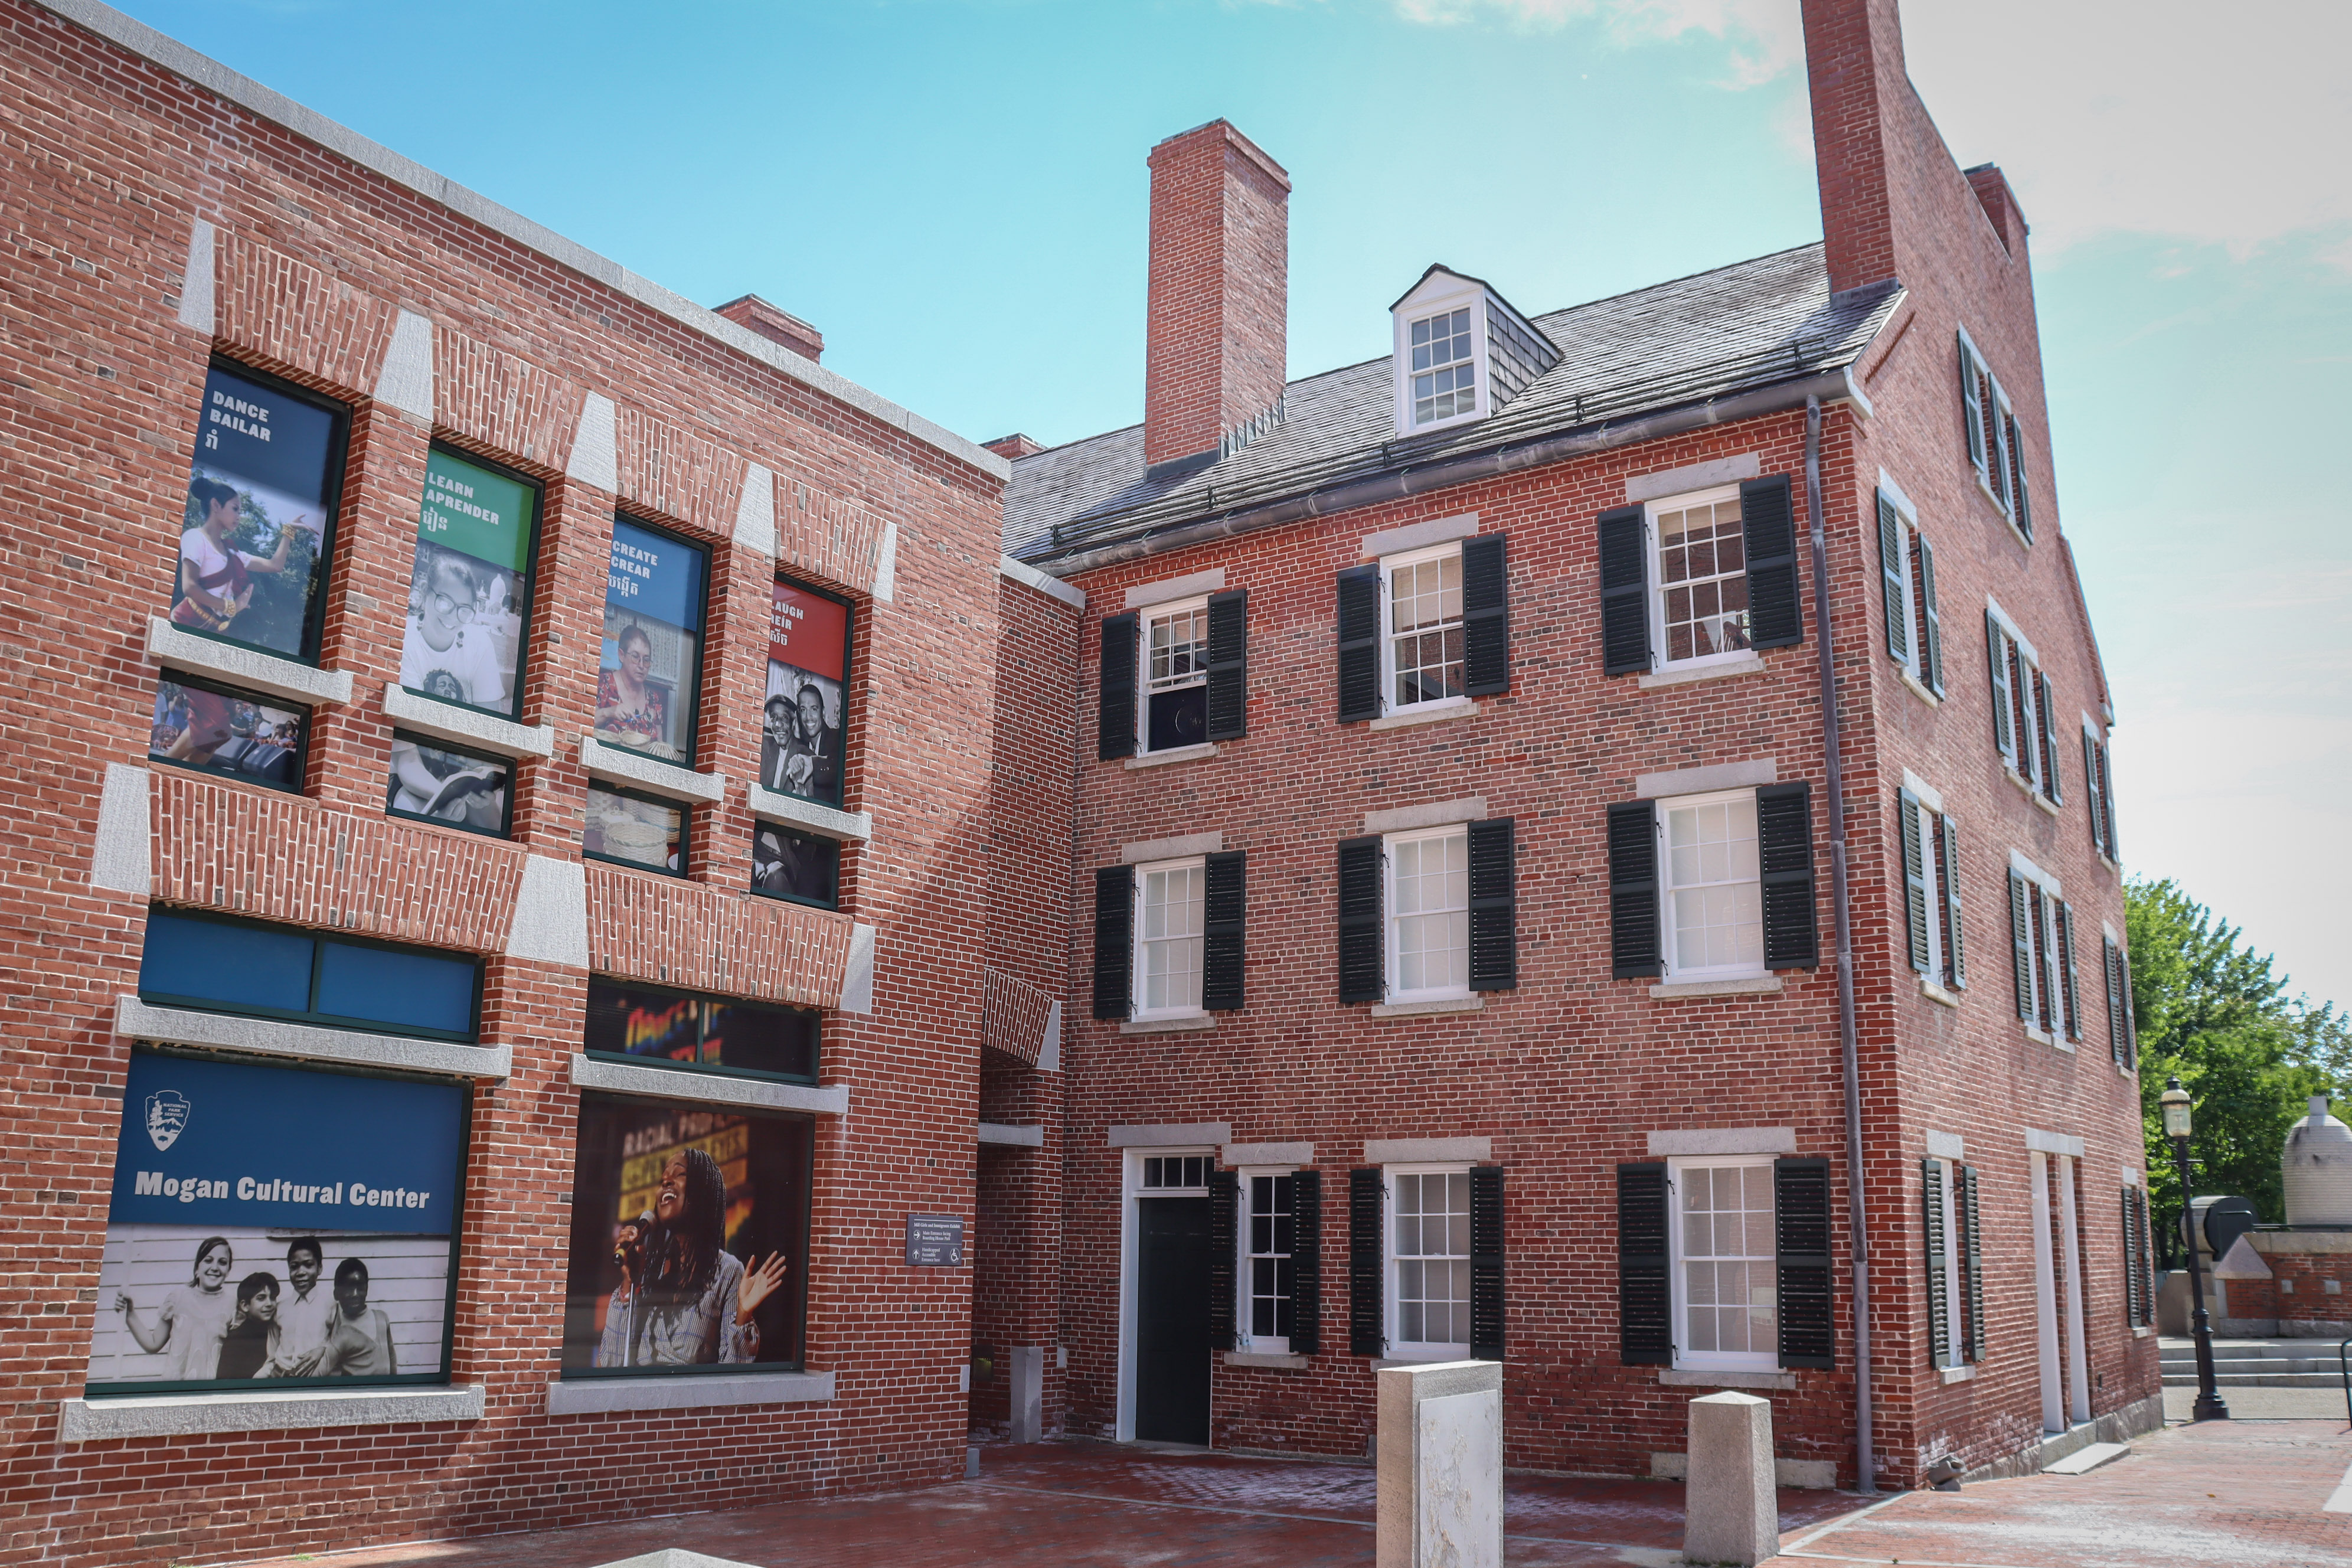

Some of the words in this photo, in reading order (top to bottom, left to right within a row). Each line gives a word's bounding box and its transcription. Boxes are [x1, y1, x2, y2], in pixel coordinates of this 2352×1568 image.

[213, 390, 269, 423] DANCE
[210, 408, 271, 442] BAILAR
[428, 472, 473, 498] LEARN
[426, 489, 499, 525] APRENDER
[610, 556, 650, 579] CREAR
[612, 540, 658, 566] CREATE
[135, 1171, 229, 1203] Mogan
[236, 1177, 342, 1204] Cultural
[349, 1183, 430, 1209] Center
